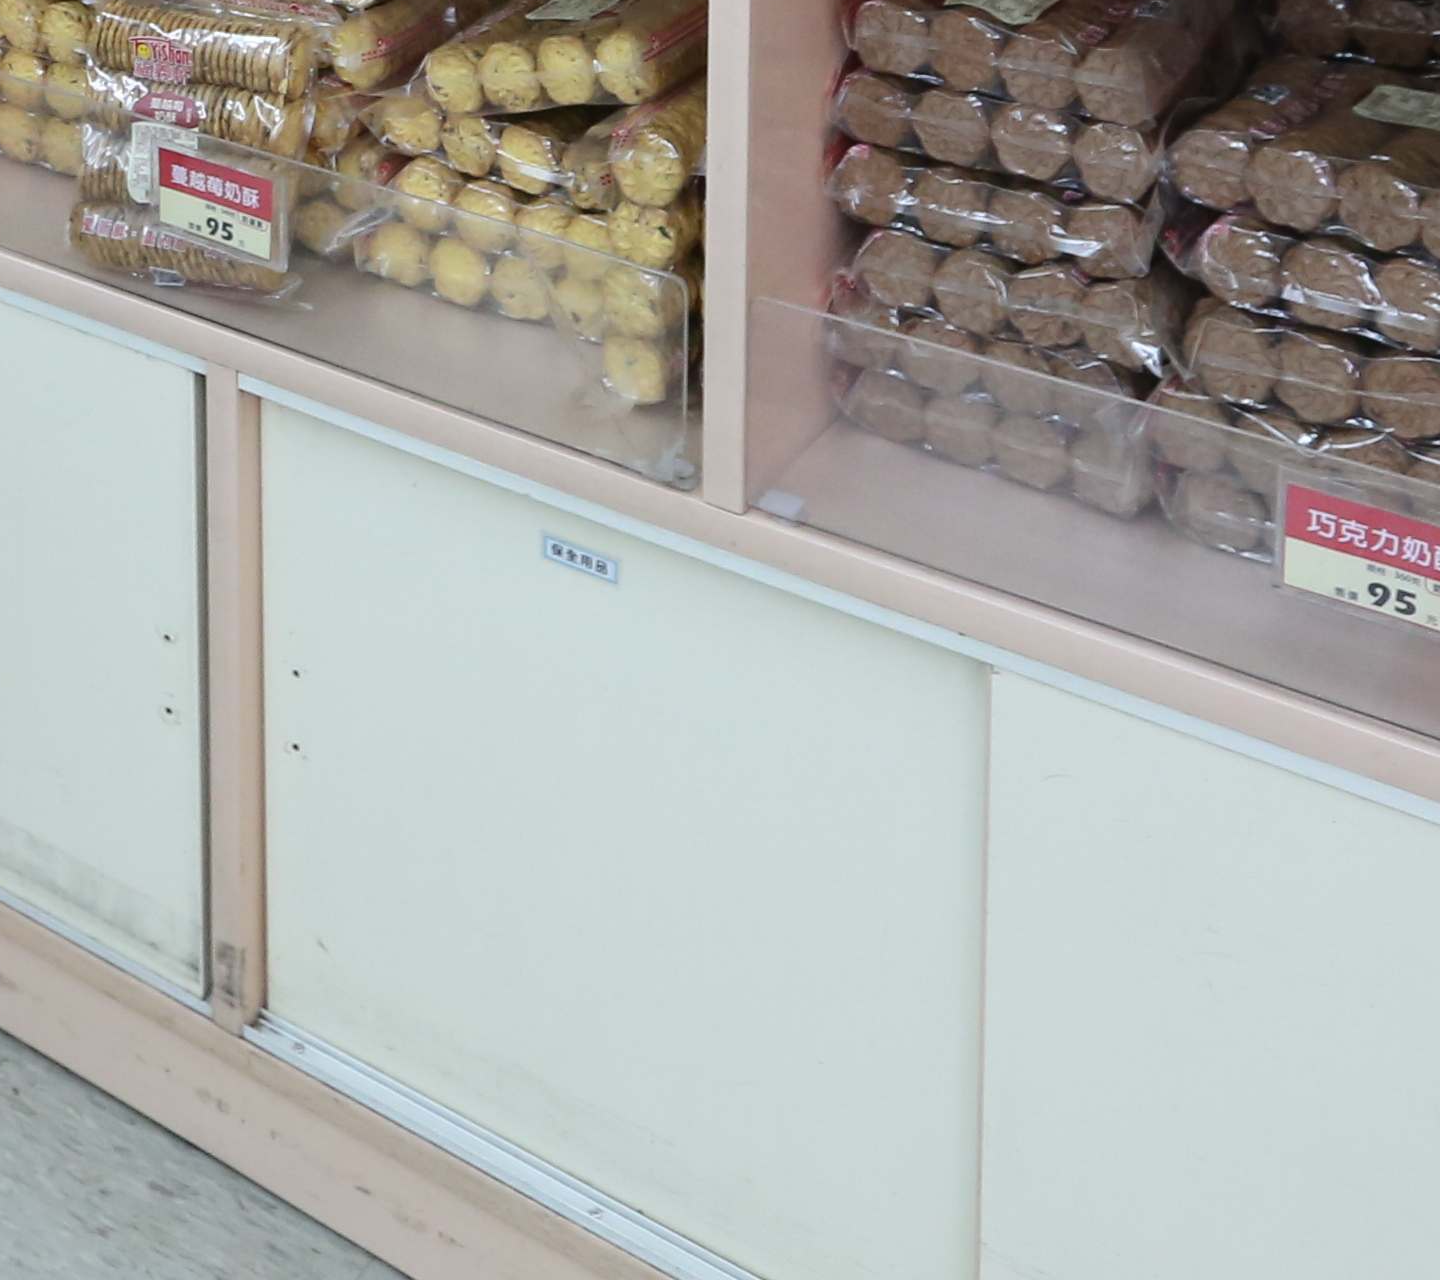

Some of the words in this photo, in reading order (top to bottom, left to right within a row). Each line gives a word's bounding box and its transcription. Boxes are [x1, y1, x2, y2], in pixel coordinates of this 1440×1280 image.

[170, 163, 261, 210] 蔓越莓奶酥
[206, 217, 234, 242] 95
[1367, 581, 1418, 617] 95
